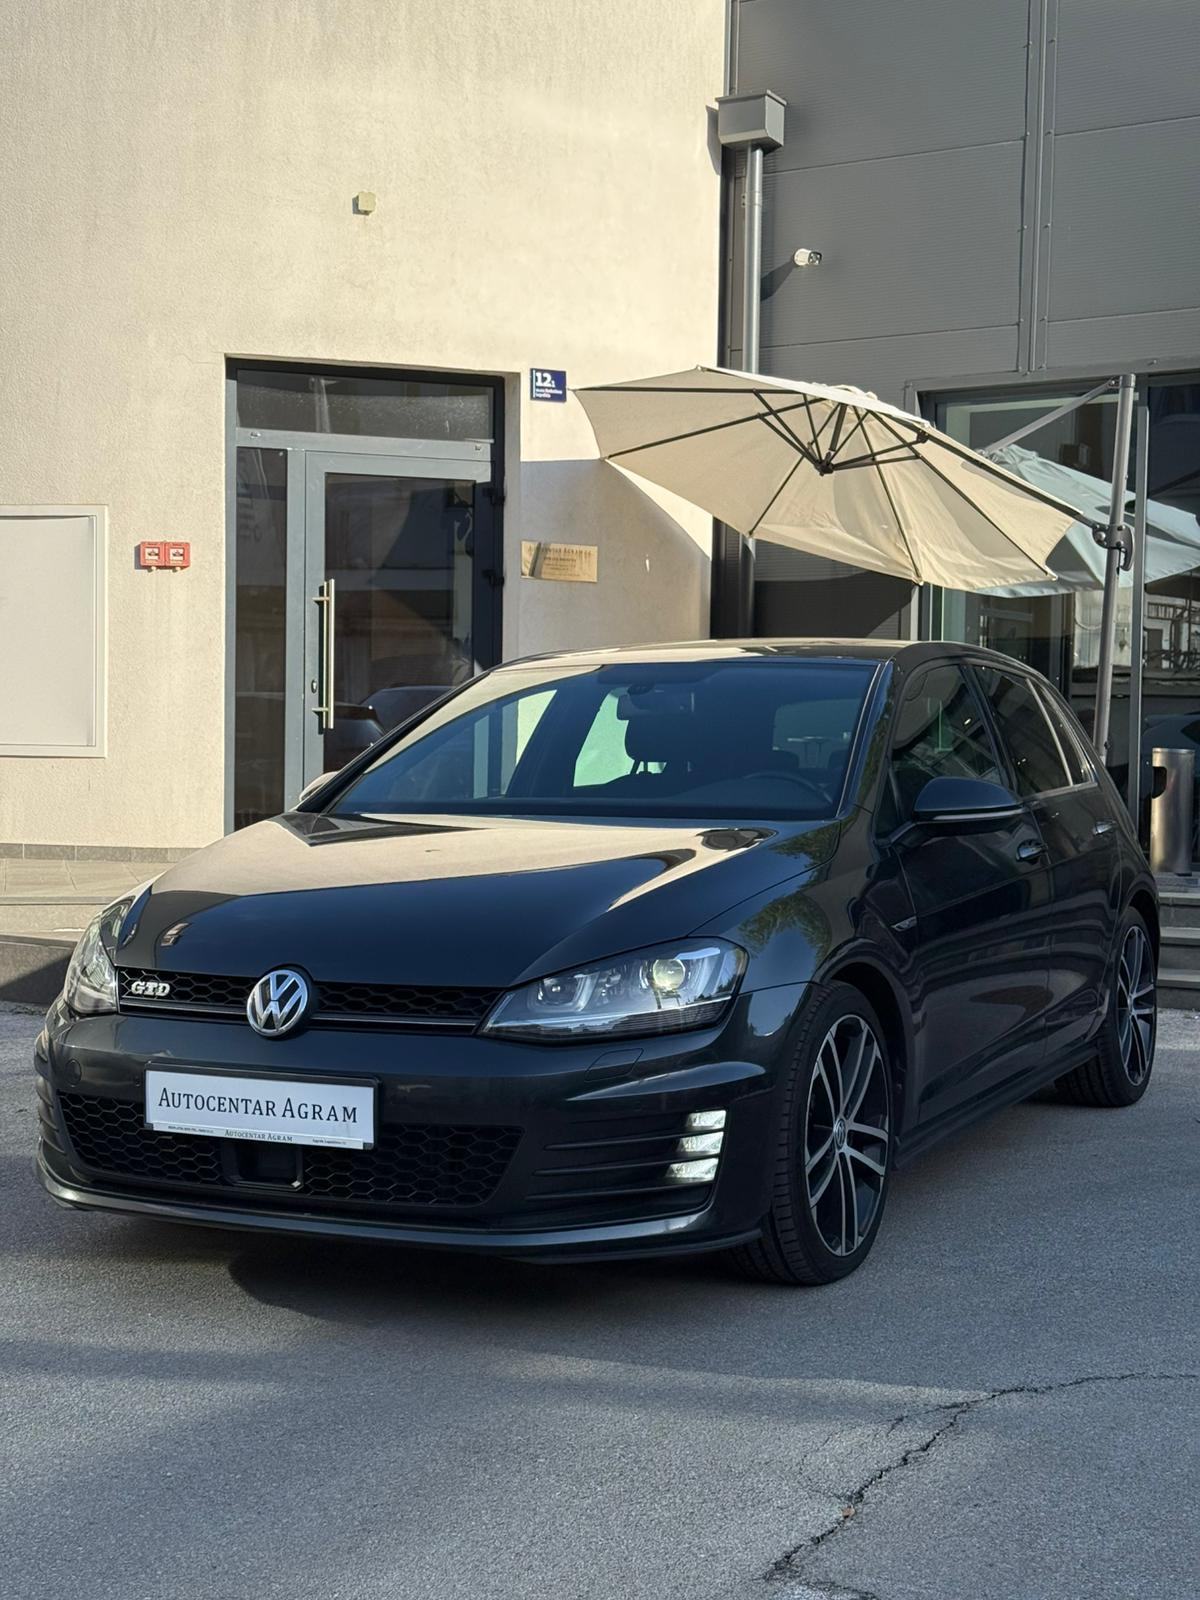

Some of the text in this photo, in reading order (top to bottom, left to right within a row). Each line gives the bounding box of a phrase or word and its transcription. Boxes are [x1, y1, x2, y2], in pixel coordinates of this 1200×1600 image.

[131, 980, 171, 997] GTD
[247, 969, 308, 1037] VW
[158, 1087, 358, 1124] AUTOCENTAR AGRAM
[224, 1129, 266, 1140] AUTOCENTAR
[267, 1133, 293, 1142] AGRAM
